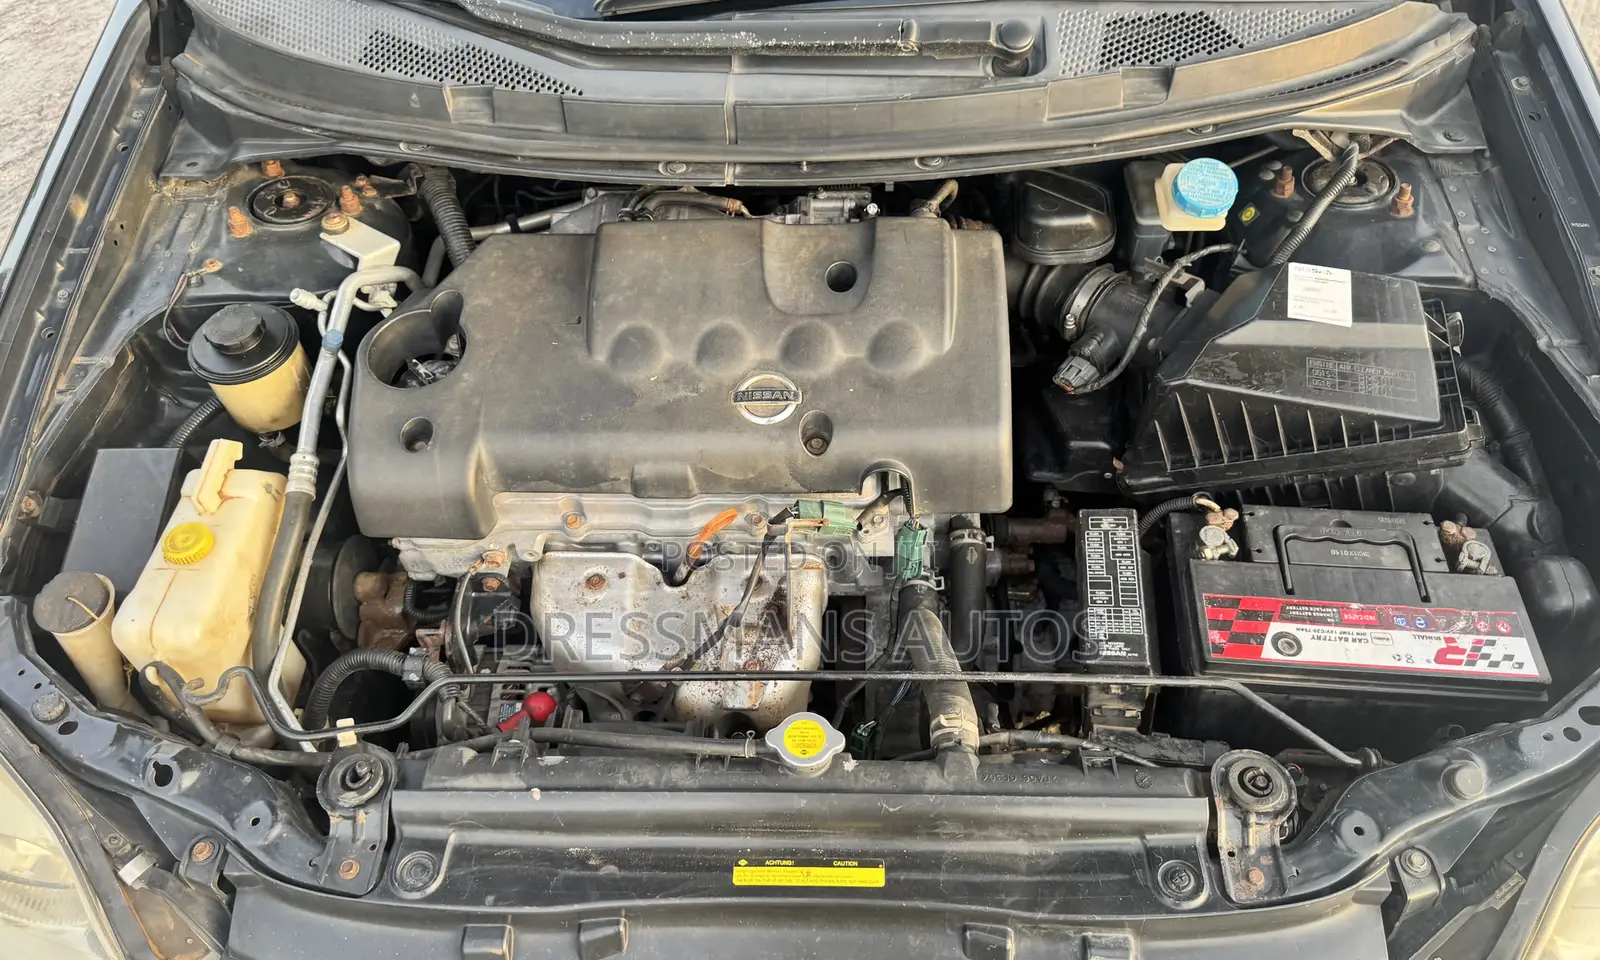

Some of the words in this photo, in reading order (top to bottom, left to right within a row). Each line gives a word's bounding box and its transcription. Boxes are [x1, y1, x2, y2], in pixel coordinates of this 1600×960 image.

[737, 391, 795, 401] NISSAN
[1310, 633, 1349, 642] BATTERY
[1351, 636, 1369, 644] CAR
